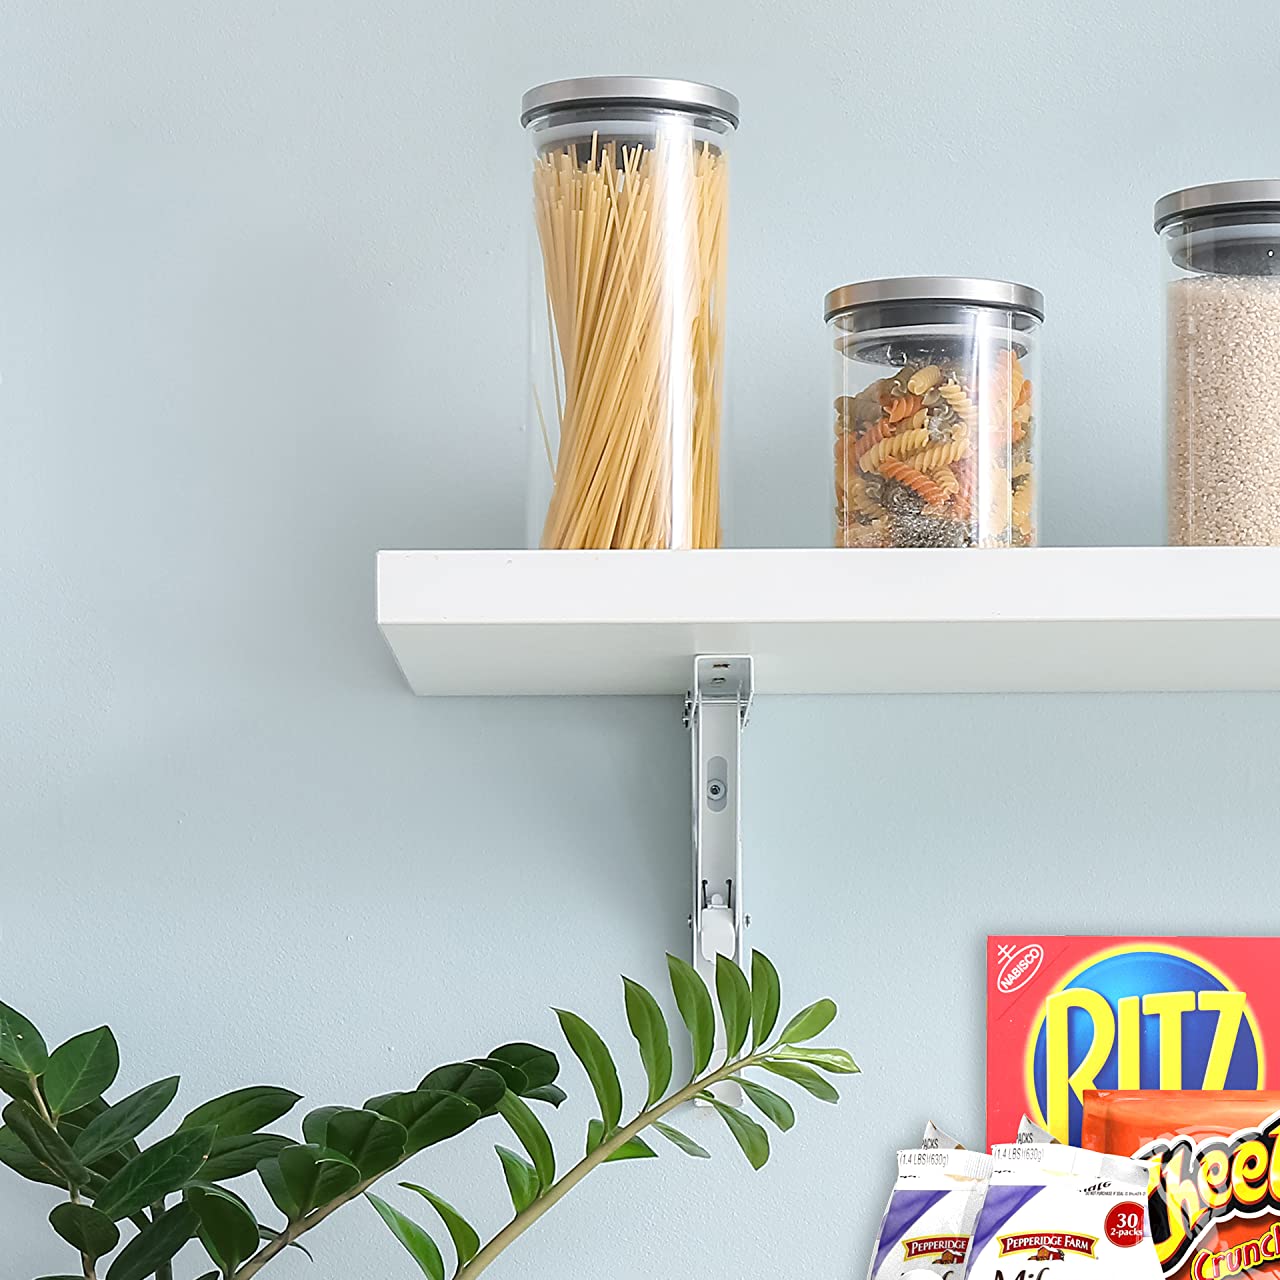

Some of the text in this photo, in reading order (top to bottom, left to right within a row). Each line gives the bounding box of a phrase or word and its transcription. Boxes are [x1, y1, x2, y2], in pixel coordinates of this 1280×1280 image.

[1000, 947, 1041, 991] NABISCO
[1046, 988, 1247, 1149] RITZ
[1116, 1213, 1139, 1229] 30
[1110, 1227, 1143, 1239] 2-packs
[911, 1239, 967, 1254] PEPPERIDGE
[1006, 1235, 1089, 1251] PEPPERIDGE FARM
